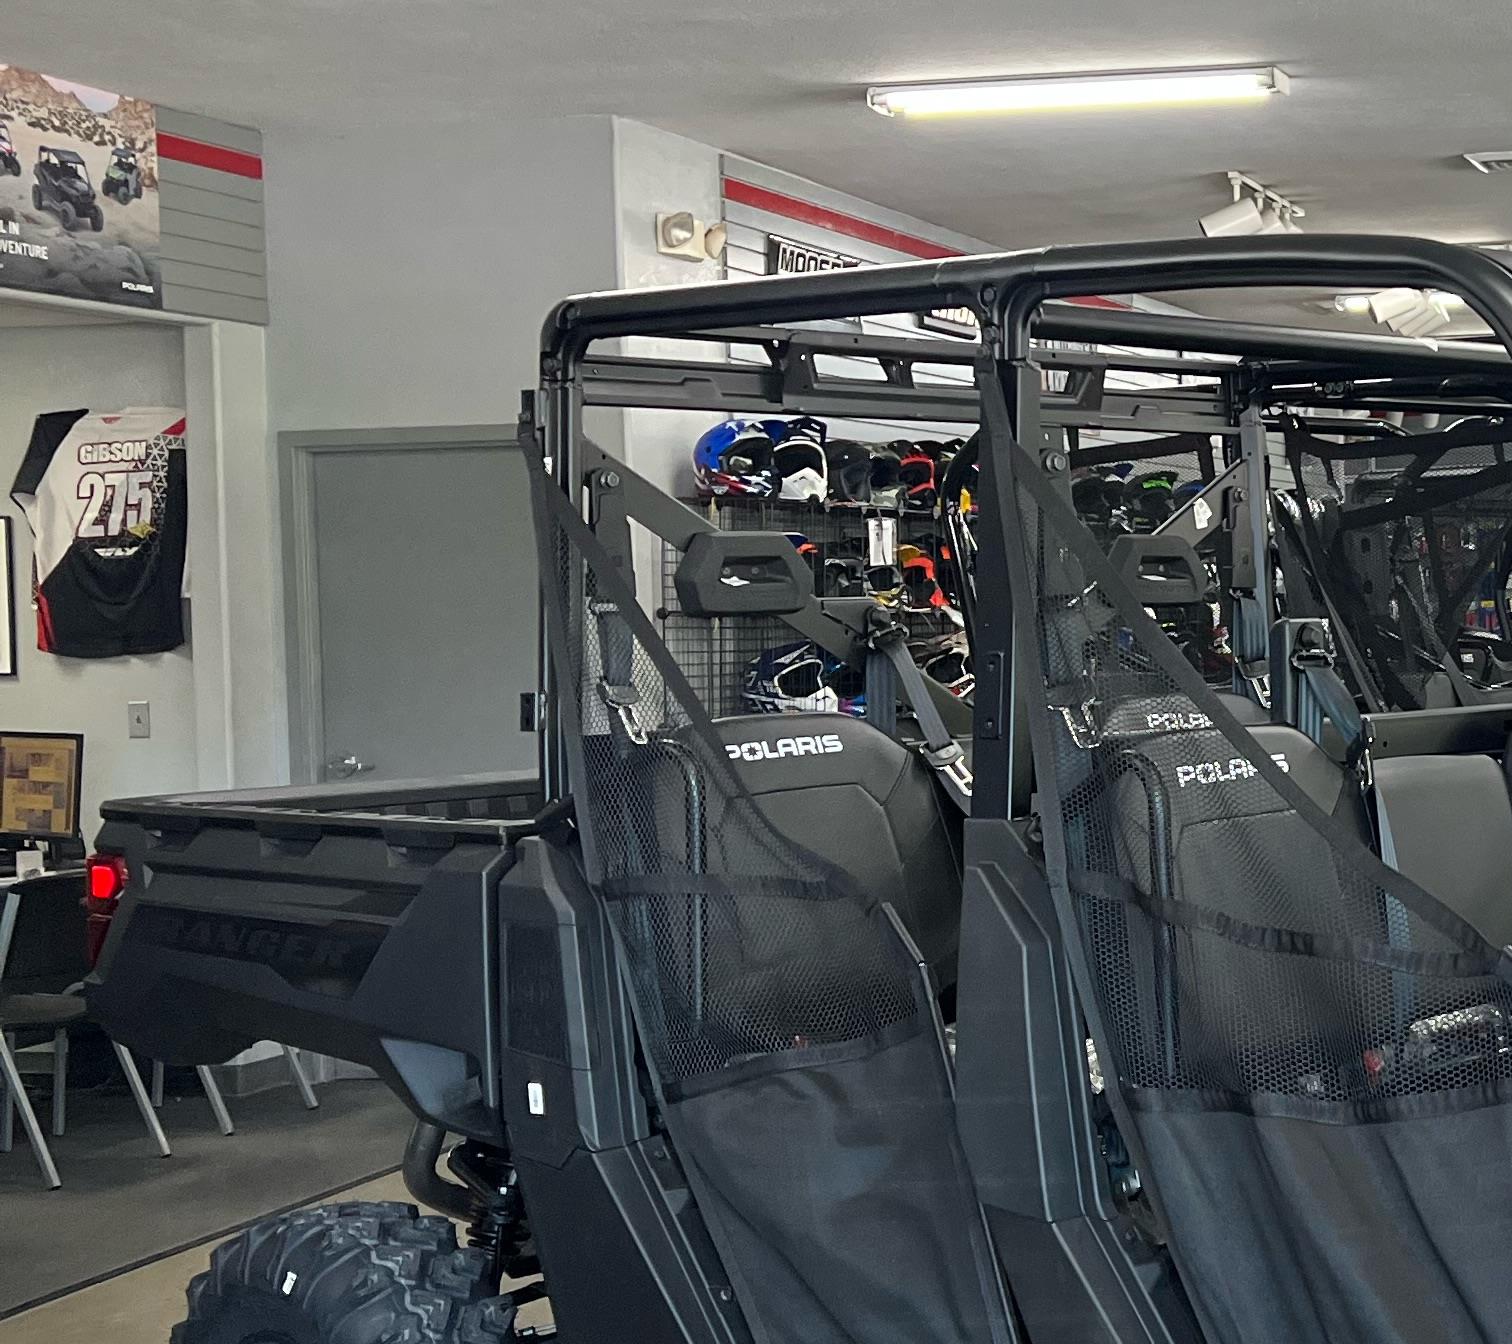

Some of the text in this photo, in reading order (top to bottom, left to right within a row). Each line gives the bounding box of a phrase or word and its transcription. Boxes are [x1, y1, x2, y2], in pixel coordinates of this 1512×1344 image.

[8, 221, 20, 236] IN
[78, 441, 148, 464] GIBSON
[76, 471, 153, 540] 275
[724, 733, 845, 762] POLARIS
